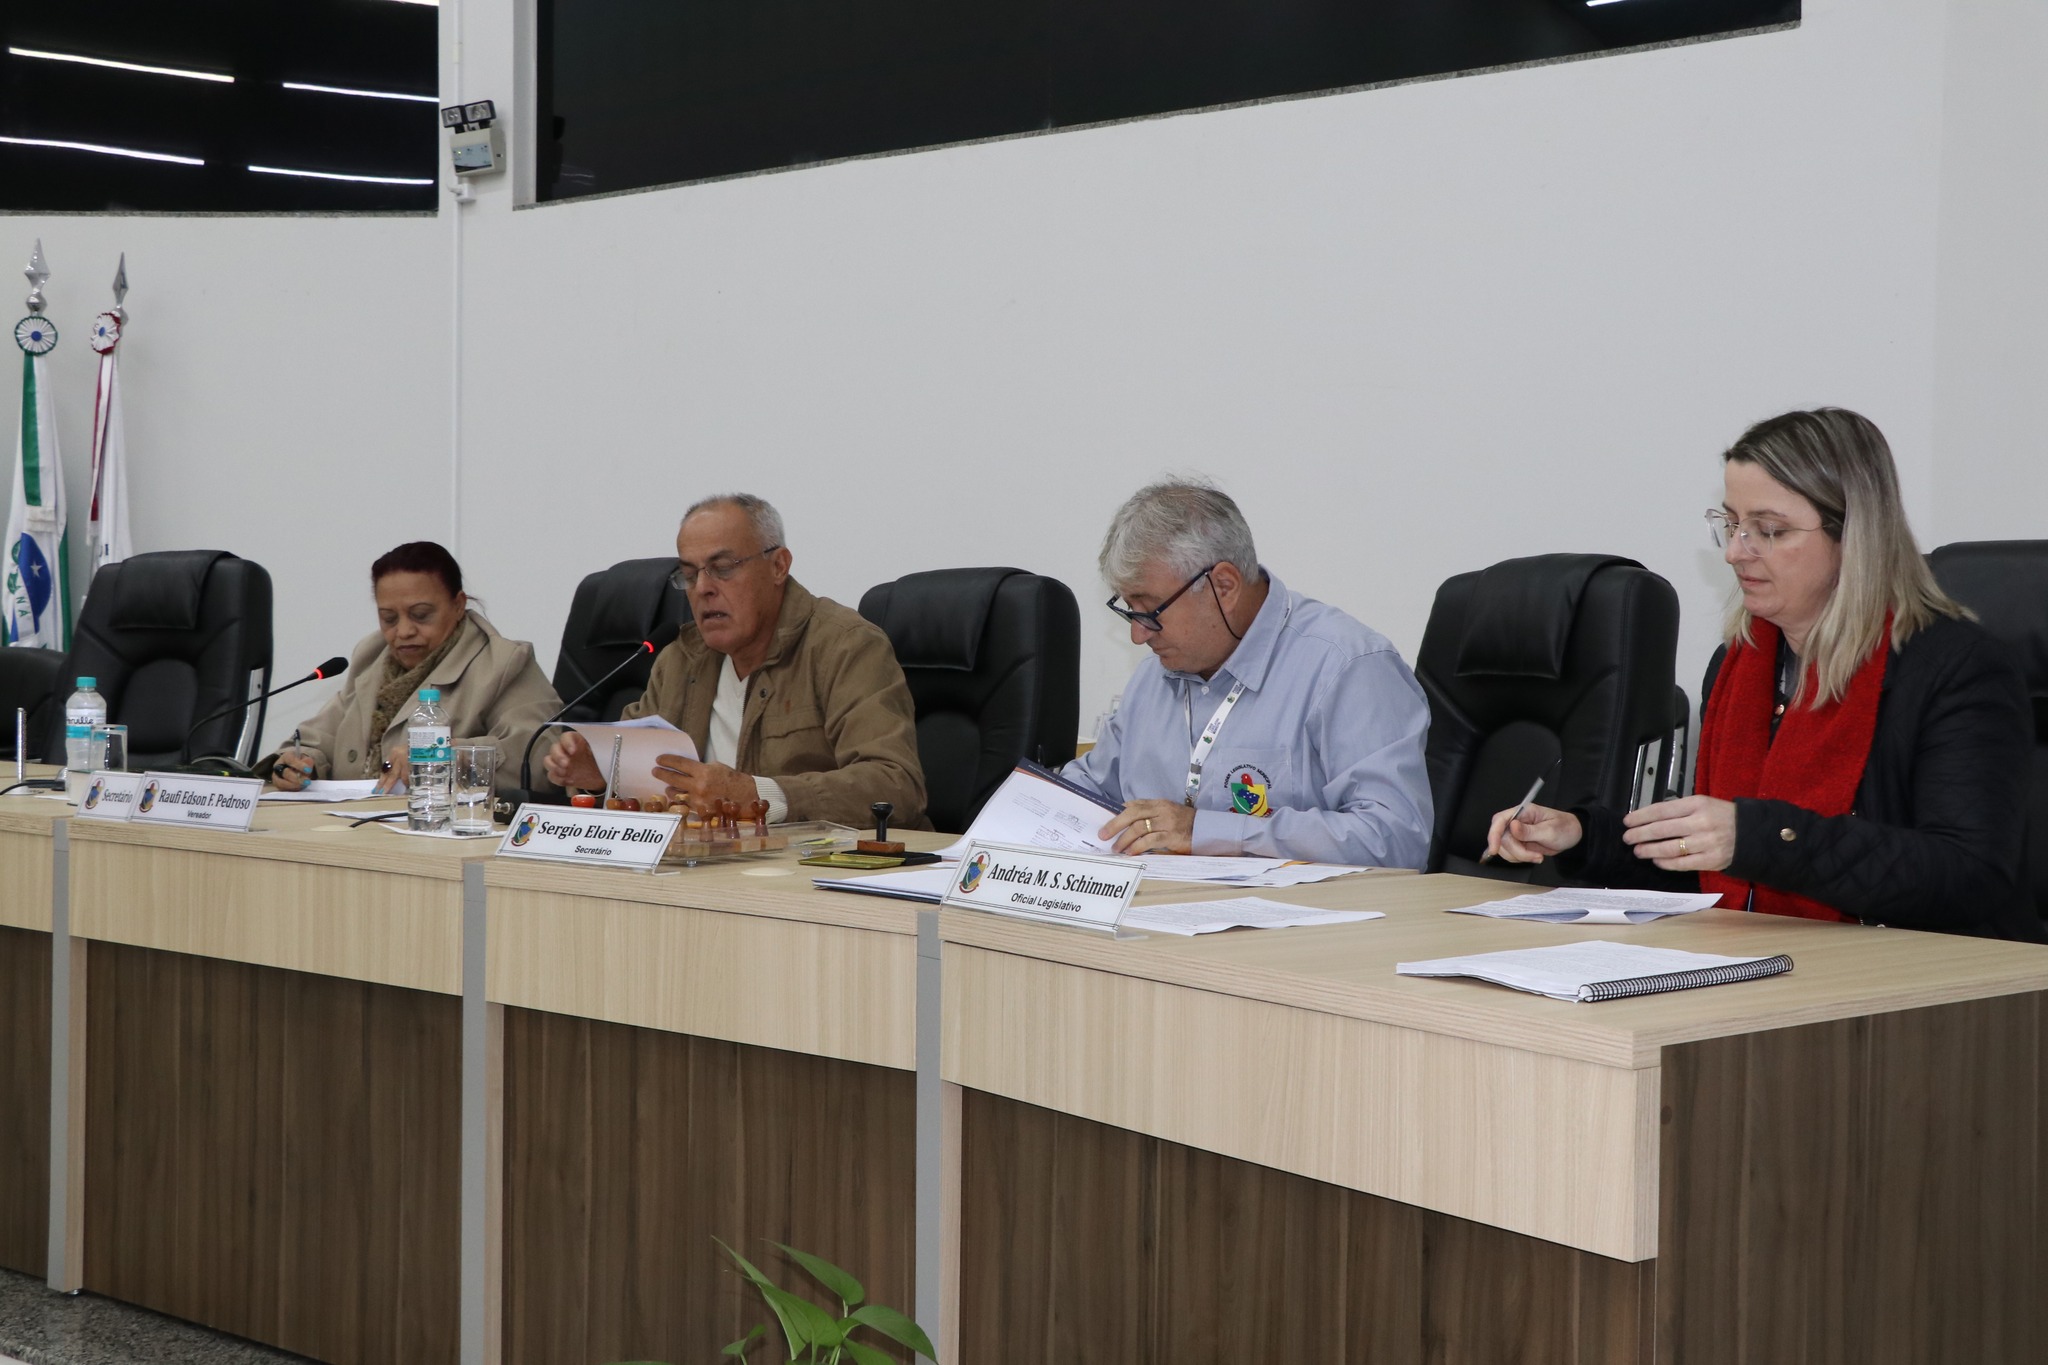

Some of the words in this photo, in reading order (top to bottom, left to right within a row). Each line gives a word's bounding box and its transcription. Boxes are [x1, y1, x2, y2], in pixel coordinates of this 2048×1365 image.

[1223, 773, 1231, 788] PODER
[1230, 764, 1256, 774] LEGISLATIVO
[1256, 769, 1272, 789] MUNICIPAL
[101, 788, 133, 804] Secretário
[158, 789, 180, 804] Raufi
[181, 791, 206, 805] Edson
[207, 793, 214, 806] F.
[215, 794, 251, 810] Pedroso
[187, 810, 212, 820] Vereador
[537, 821, 584, 840] Sergio
[584, 825, 620, 841] Eloir
[621, 828, 664, 844] Bellio
[574, 845, 612, 856] Secretário
[987, 863, 1031, 886] Andréa
[1033, 869, 1049, 888] M.
[1050, 872, 1060, 889] S.
[1062, 873, 1130, 899] Schimmel
[1010, 892, 1036, 905] Oficial
[1037, 898, 1082, 913] Legislativo
